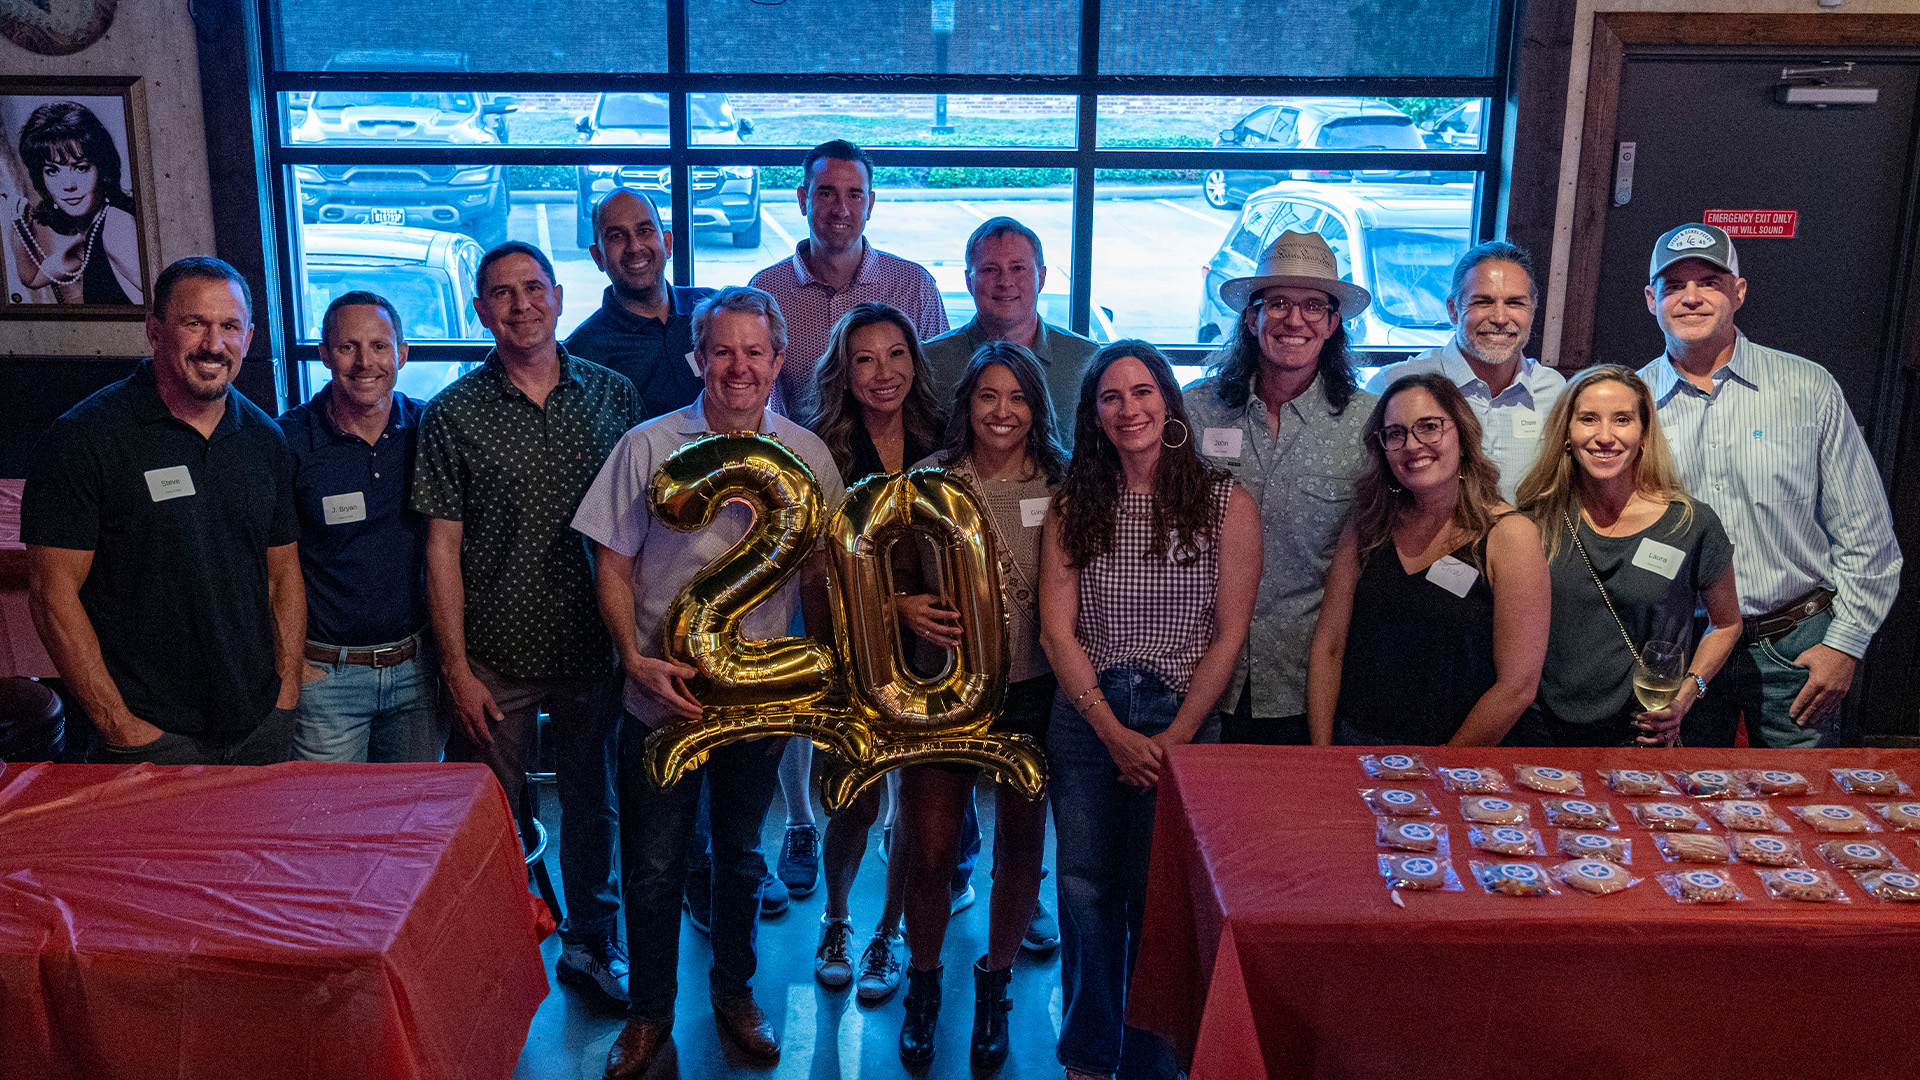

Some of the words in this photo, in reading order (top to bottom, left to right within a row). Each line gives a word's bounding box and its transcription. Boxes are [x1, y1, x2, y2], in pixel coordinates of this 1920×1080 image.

[1707, 213, 1753, 223] EMERGENCY
[1755, 213, 1771, 223] EXIT
[1772, 213, 1793, 223] ONLY
[1719, 226, 1739, 234] ARM
[1740, 226, 1757, 234] WILL
[1758, 226, 1784, 234] SOUND
[1700, 232, 1713, 242] FEEDS
[161, 479, 180, 487] Steve
[339, 505, 358, 513] Bryan
[1648, 552, 1668, 563] Laura
[649, 432, 1010, 734] 20
